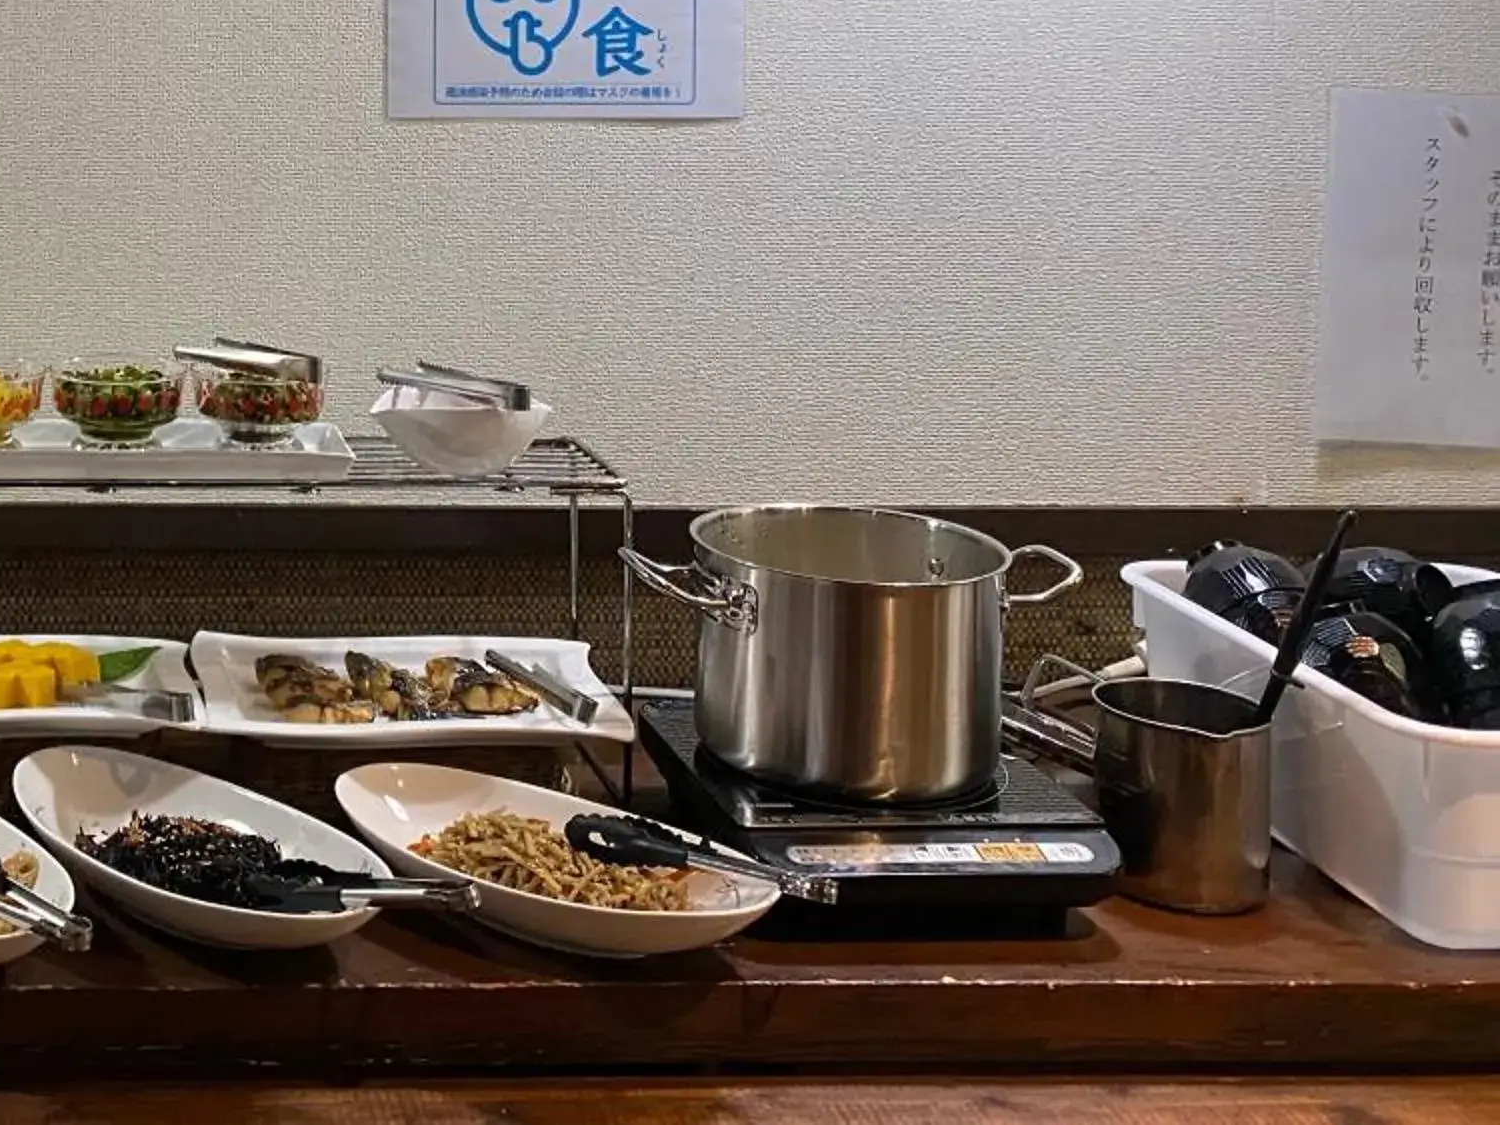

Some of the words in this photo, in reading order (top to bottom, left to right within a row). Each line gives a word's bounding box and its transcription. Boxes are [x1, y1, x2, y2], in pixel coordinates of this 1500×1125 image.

[1412, 137, 1442, 381] スタッフにより回収します。
